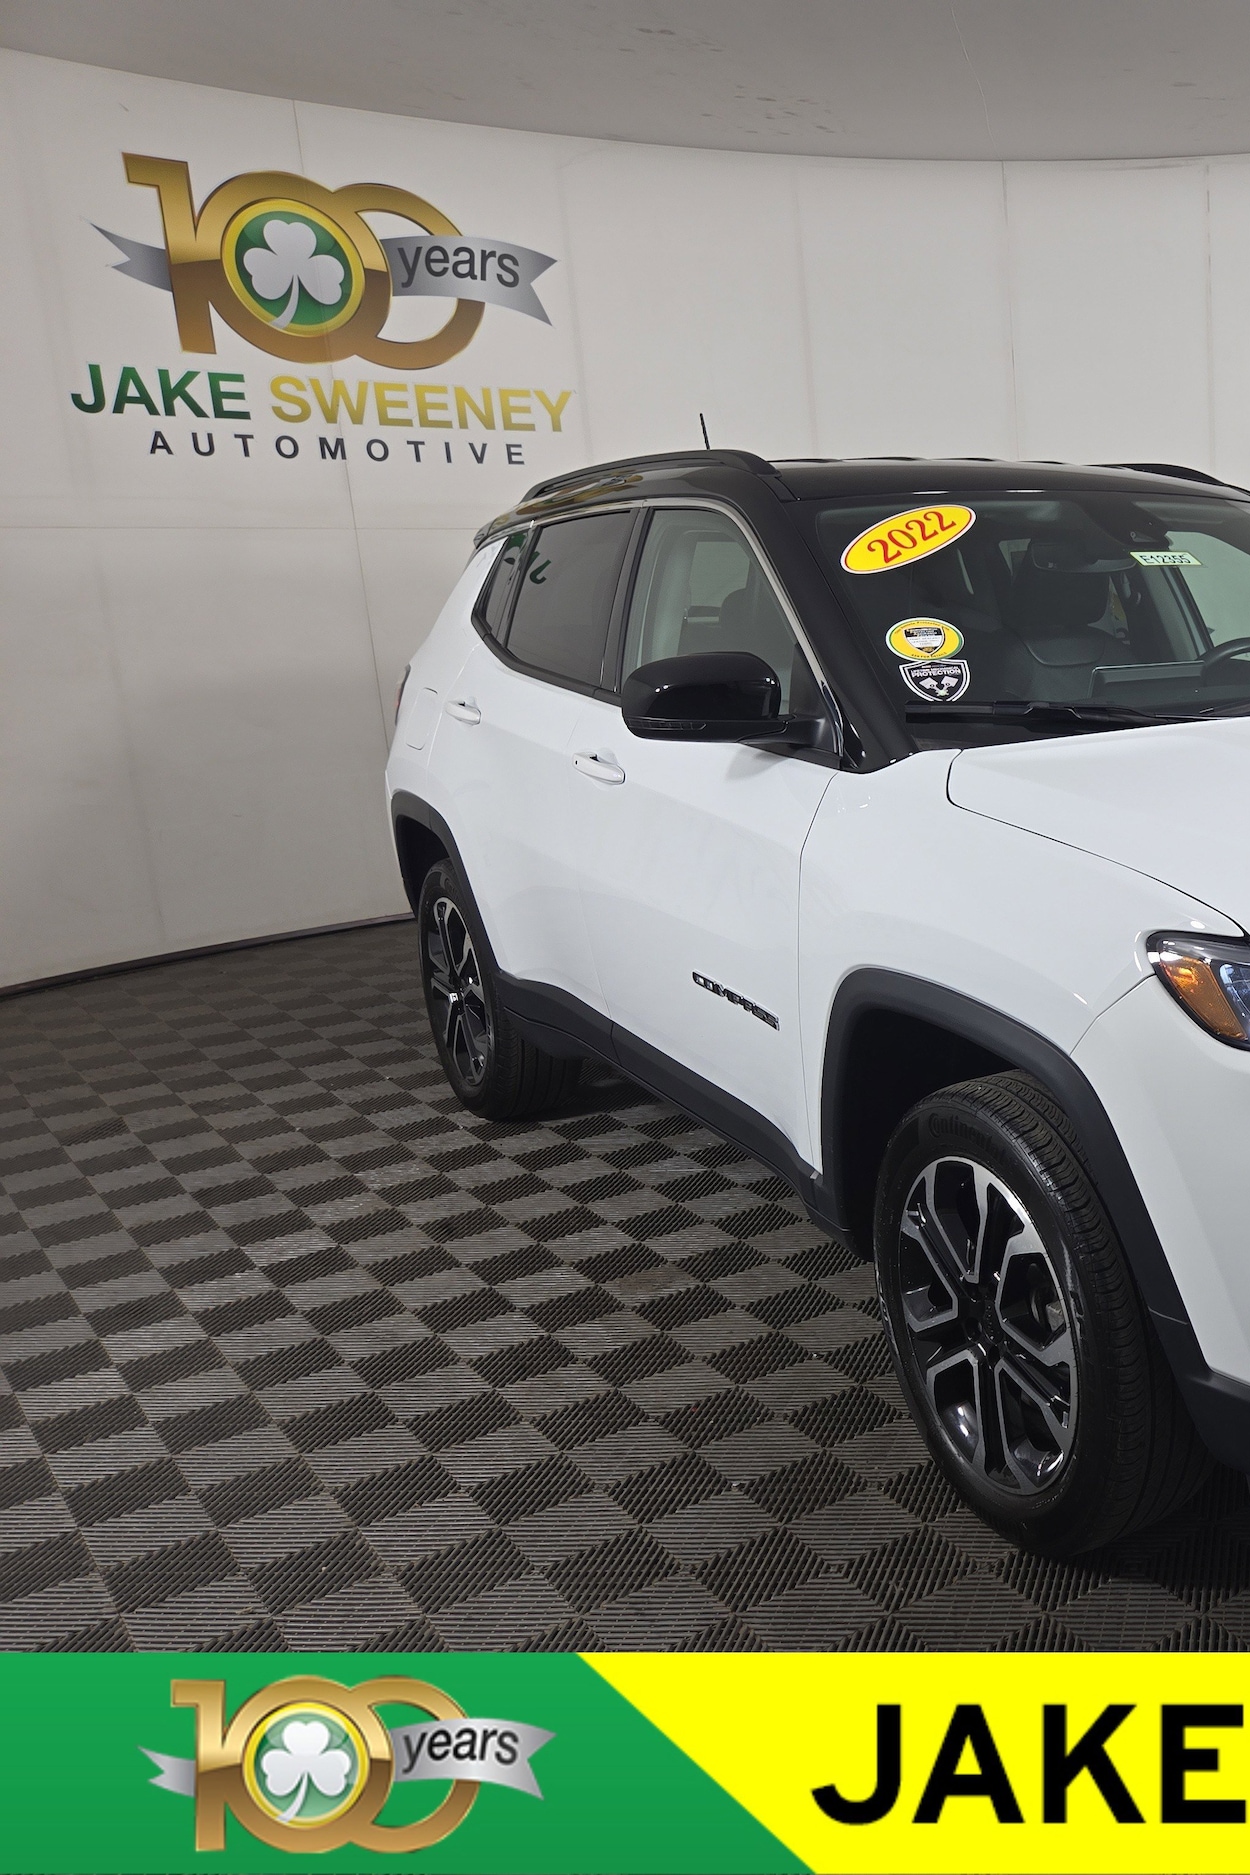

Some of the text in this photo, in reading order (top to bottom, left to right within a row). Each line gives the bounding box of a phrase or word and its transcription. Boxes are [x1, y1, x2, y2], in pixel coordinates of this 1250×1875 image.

[121, 151, 521, 370] 100 years
[70, 363, 573, 433] JAKE SWEENEY
[149, 430, 526, 466] AUTOMOTIVE
[867, 510, 957, 564] 2022
